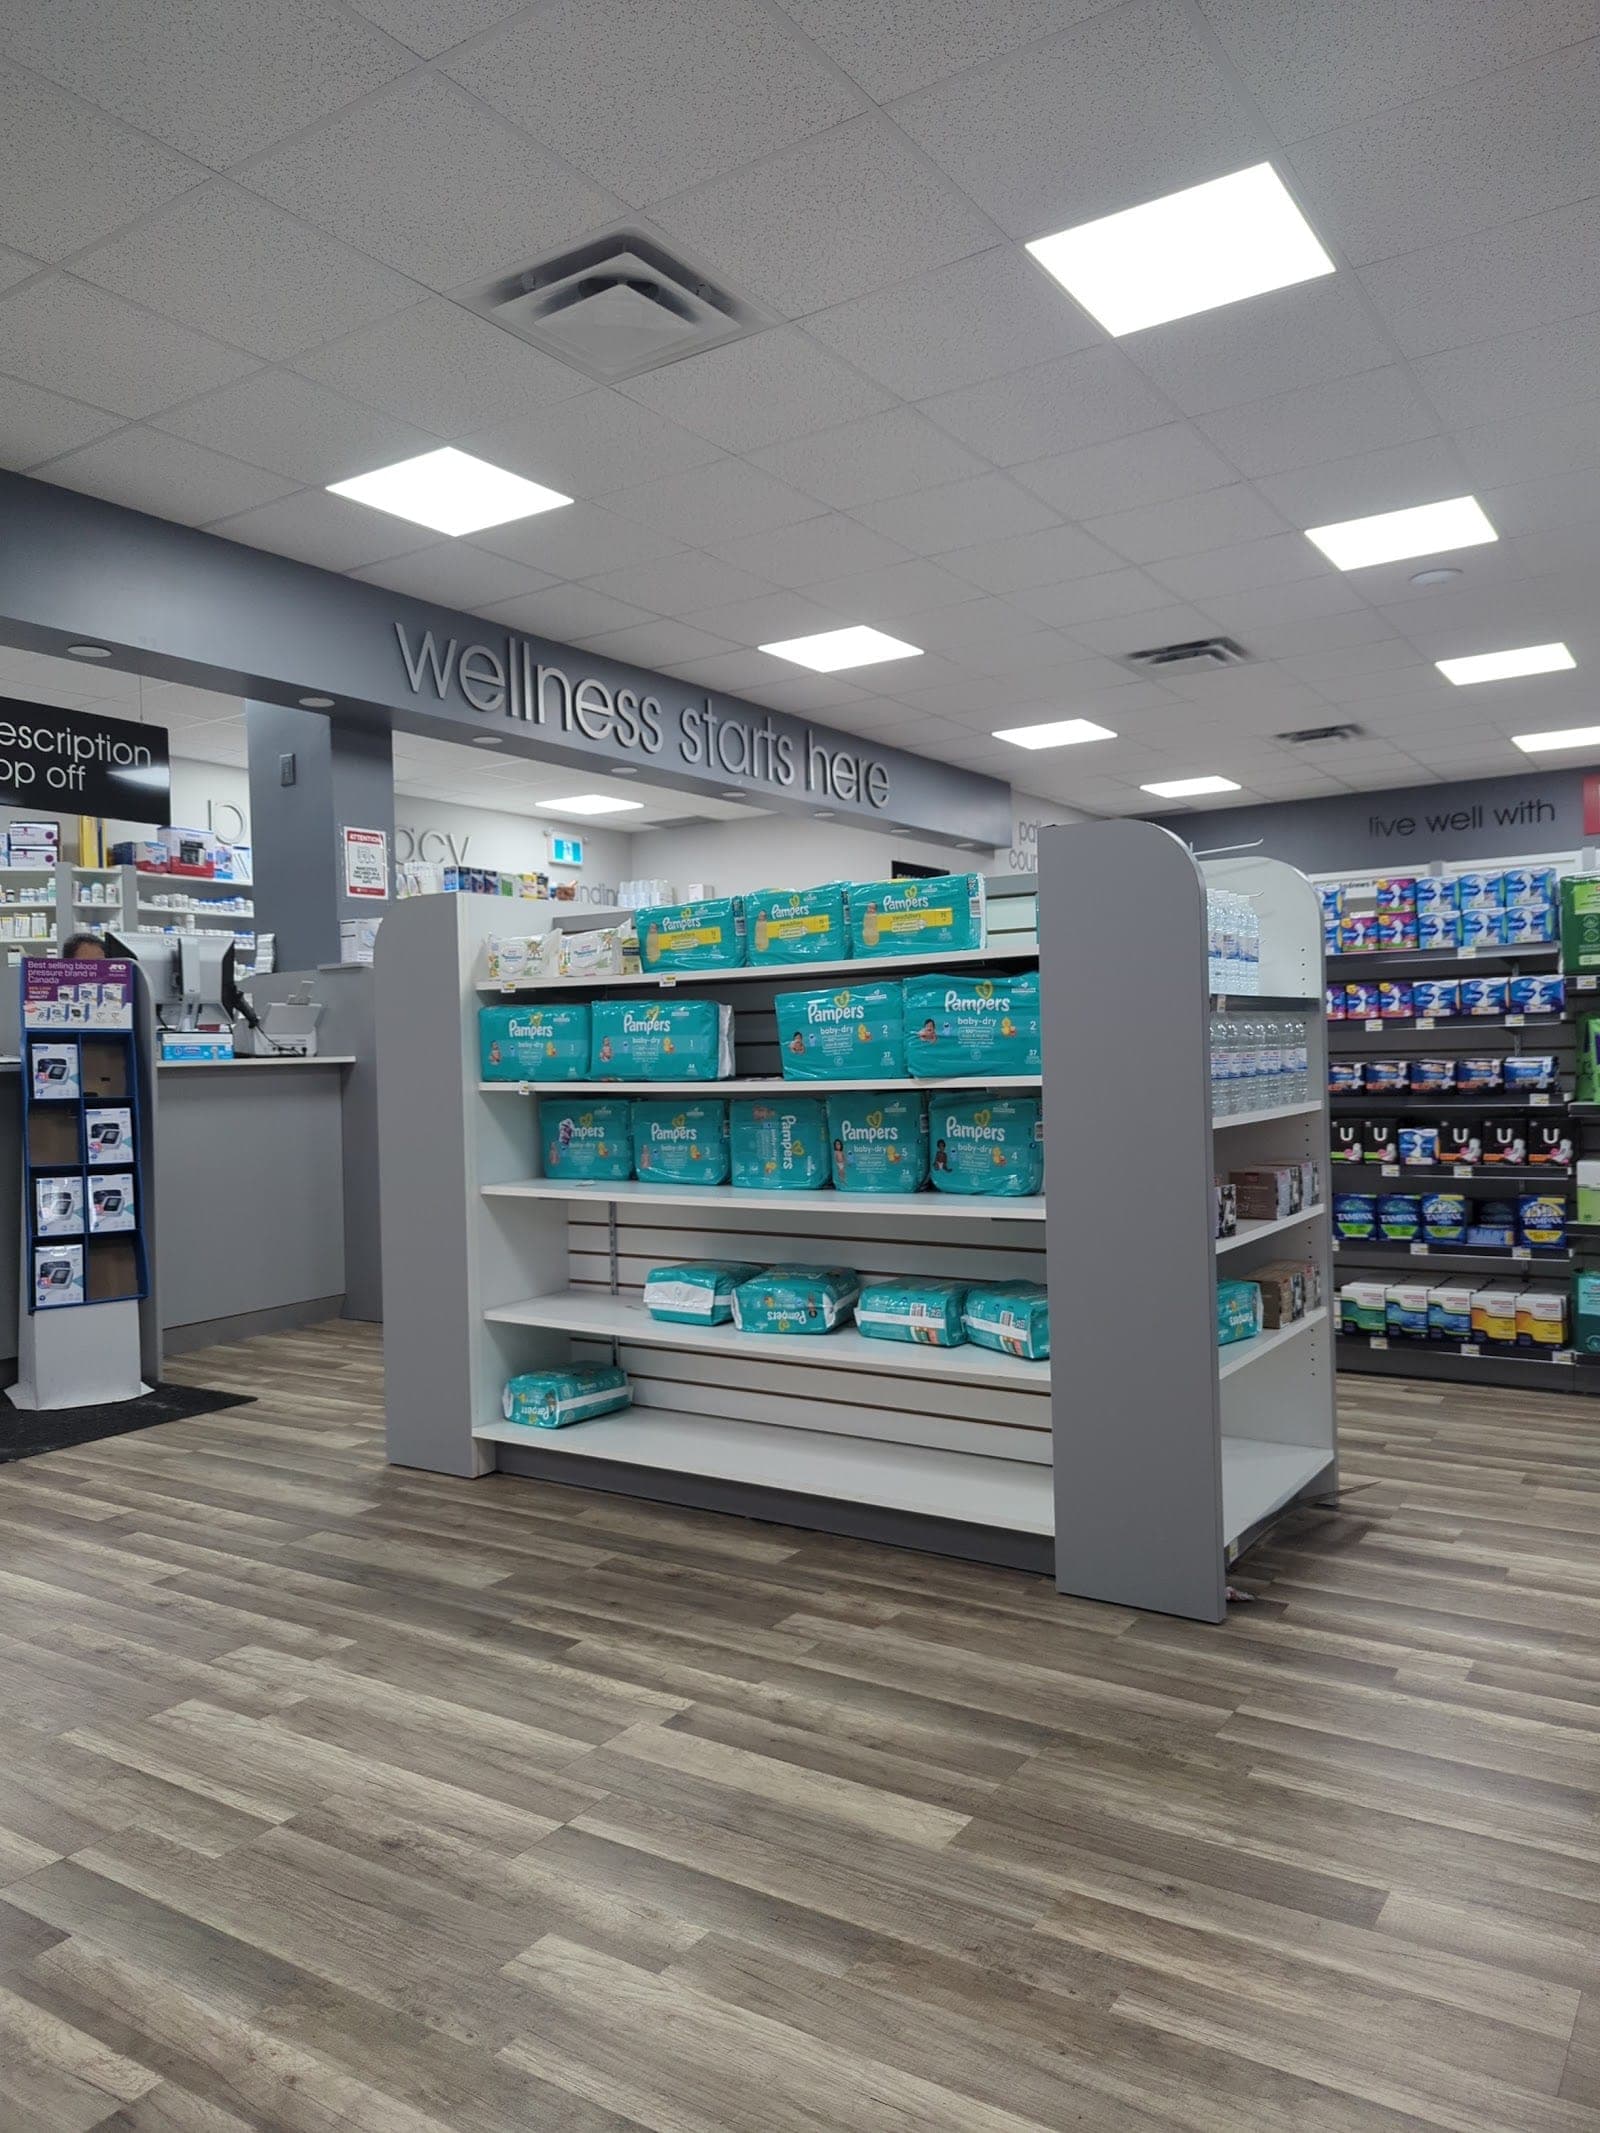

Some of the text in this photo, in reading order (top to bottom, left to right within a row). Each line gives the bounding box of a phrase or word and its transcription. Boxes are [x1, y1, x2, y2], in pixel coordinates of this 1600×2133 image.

[393, 621, 891, 809] wellness starts here
[46, 764, 87, 791] off
[1368, 799, 1556, 838] live well with
[883, 895, 929, 912] Pampers
[771, 904, 810, 919] Pampers
[662, 917, 701, 931] Pampers
[28, 961, 98, 970] Best selling blood
[28, 970, 63, 978] pressure
[945, 990, 1011, 1014] Pampers
[808, 1003, 864, 1024] Pampers
[509, 1019, 553, 1038] Pampers
[623, 1014, 670, 1033] Pampers
[882, 1025, 888, 1034] 2
[957, 1017, 997, 1027] baby-dry
[1030, 1021, 1037, 1030] 2
[820, 1025, 854, 1036] baby-dry
[632, 1037, 661, 1046] baby-dry
[651, 1122, 697, 1143] Pampers
[841, 1120, 898, 1143] Pampers
[946, 1115, 1006, 1142] Pampers
[1340, 1127, 1354, 1141] U
[1373, 1127, 1388, 1141] U
[1453, 1128, 1469, 1144] U
[1496, 1128, 1512, 1144] U
[1543, 1128, 1560, 1144] U
[781, 1115, 797, 1170] Pampers
[853, 1145, 887, 1154] baby-dry
[957, 1143, 992, 1154] baby-dry
[901, 1148, 908, 1157] 5
[1011, 1152, 1018, 1160] 4
[1523, 1217, 1563, 1225] TAMPAX
[767, 1310, 806, 1325] Pampers
